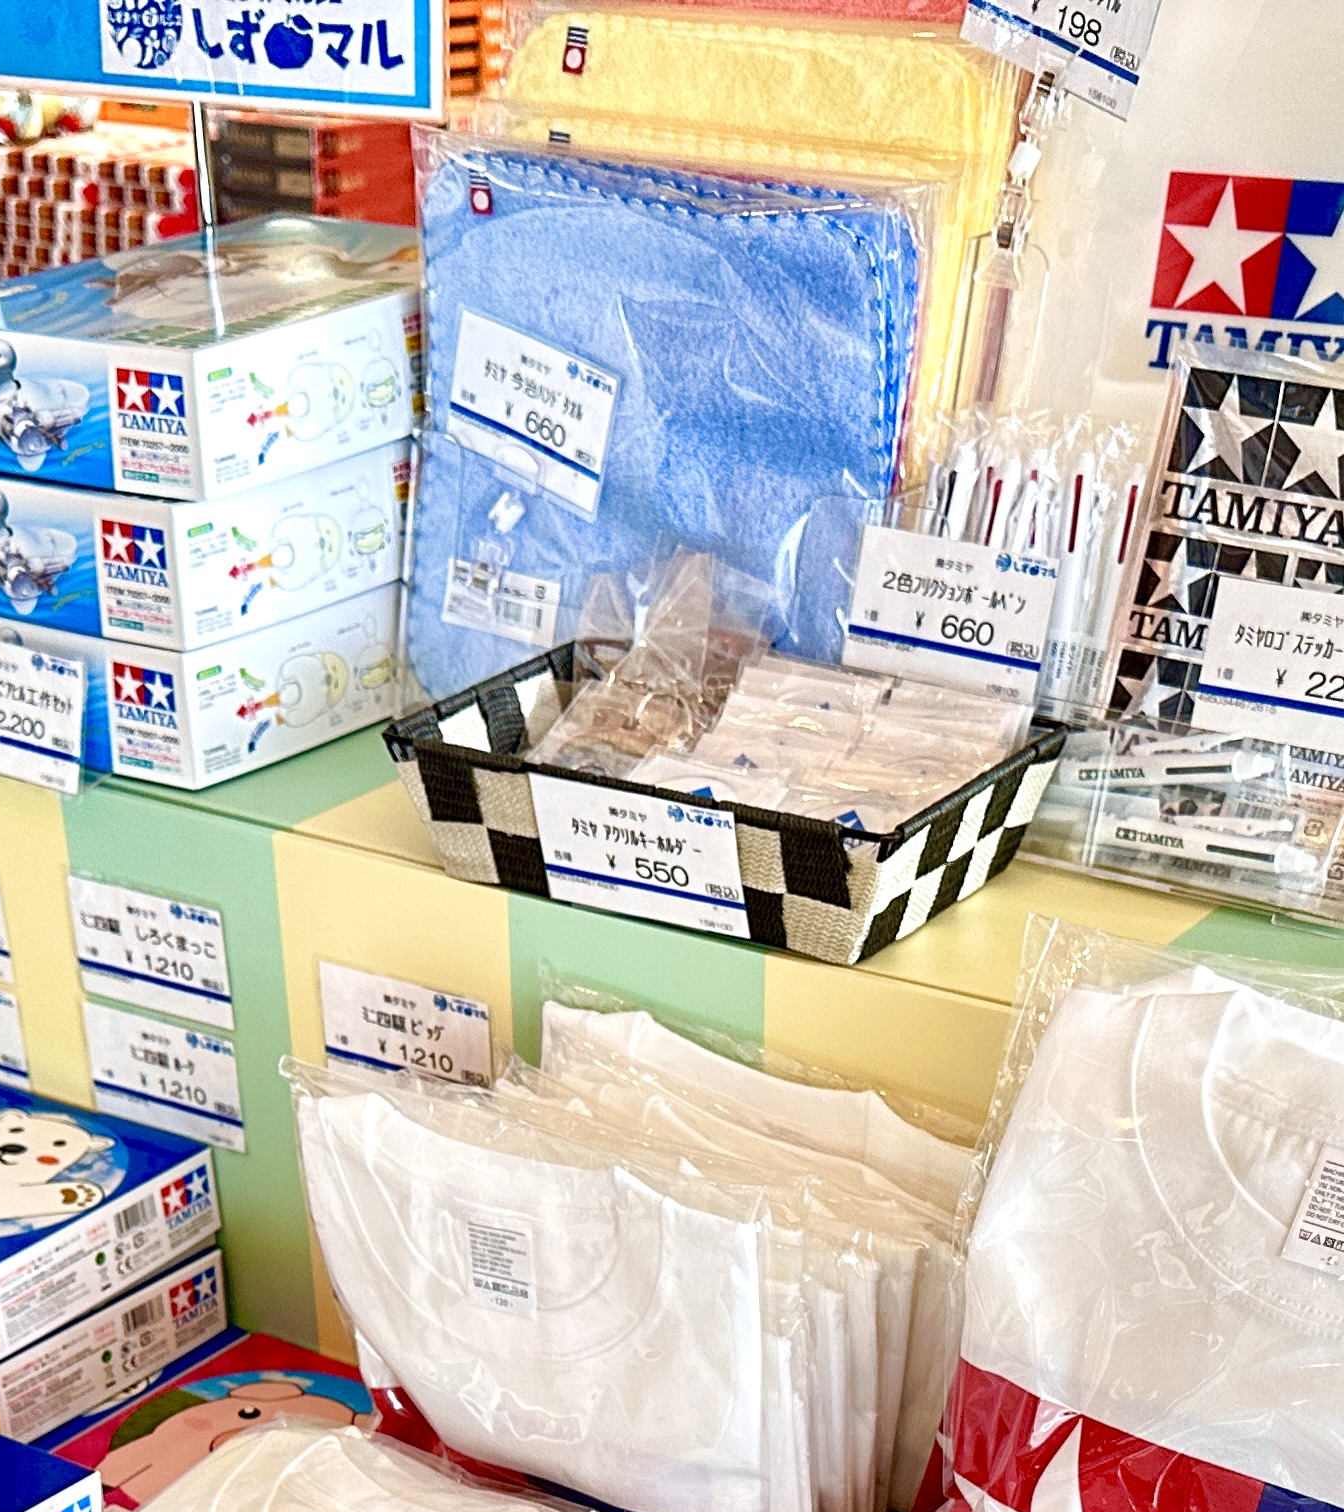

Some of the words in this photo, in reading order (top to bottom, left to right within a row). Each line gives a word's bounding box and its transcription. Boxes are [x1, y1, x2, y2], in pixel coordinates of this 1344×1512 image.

[1055, 7, 1102, 47] 198
[118, 413, 187, 436] TAMIYA
[524, 410, 566, 448] 660
[105, 563, 169, 588] TAMIYA
[915, 611, 926, 630] ¥
[941, 614, 995, 647] 660
[1276, 668, 1287, 687] ¥
[114, 702, 178, 729] TAMIYA
[571, 817, 598, 839] タミヤ
[1136, 831, 1184, 849] TAMIYA
[606, 853, 616, 870] ¥
[634, 857, 689, 888] 550
[135, 925, 216, 959] しろくまっこ
[400, 1045, 453, 1073] 1,210
[166, 1197, 212, 1229] TAMIYA
[173, 1298, 218, 1329] TAMIYA
